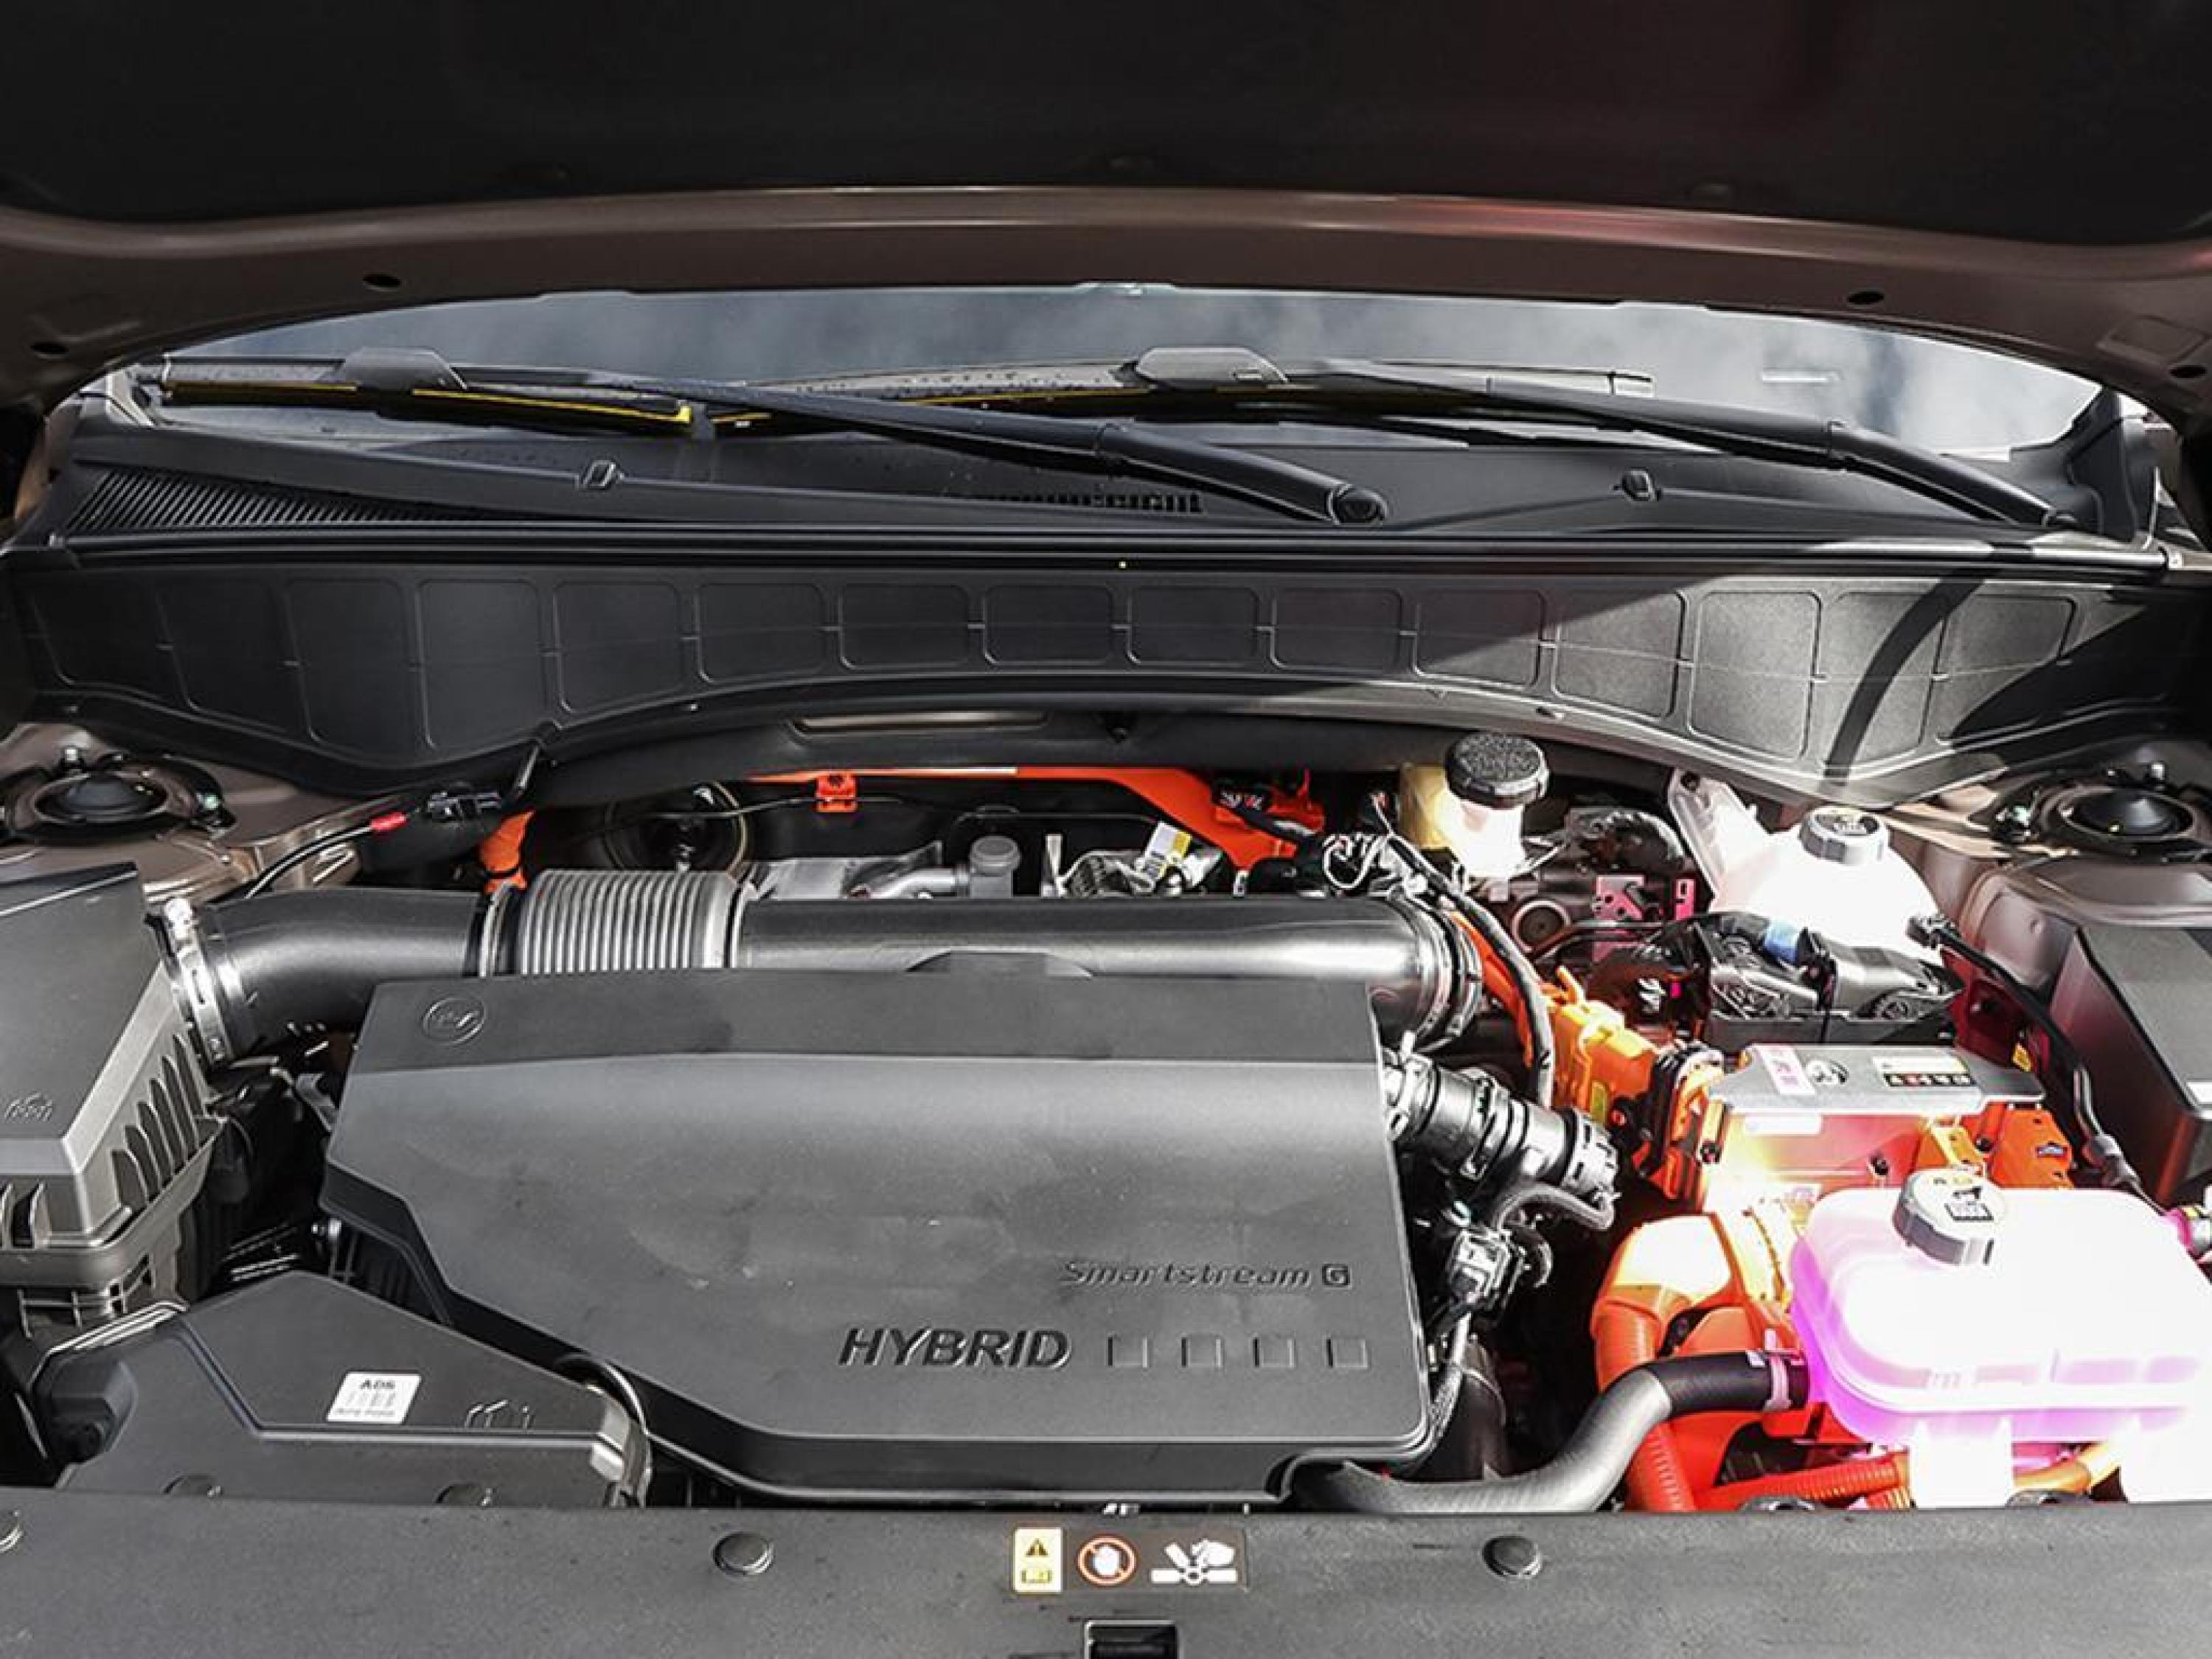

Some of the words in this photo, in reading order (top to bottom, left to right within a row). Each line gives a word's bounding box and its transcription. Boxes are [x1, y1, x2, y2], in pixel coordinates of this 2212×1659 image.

[1060, 1262, 1311, 1287] Smartstream
[1321, 1262, 1352, 1288] G
[839, 1327, 1071, 1369] HYBRID
